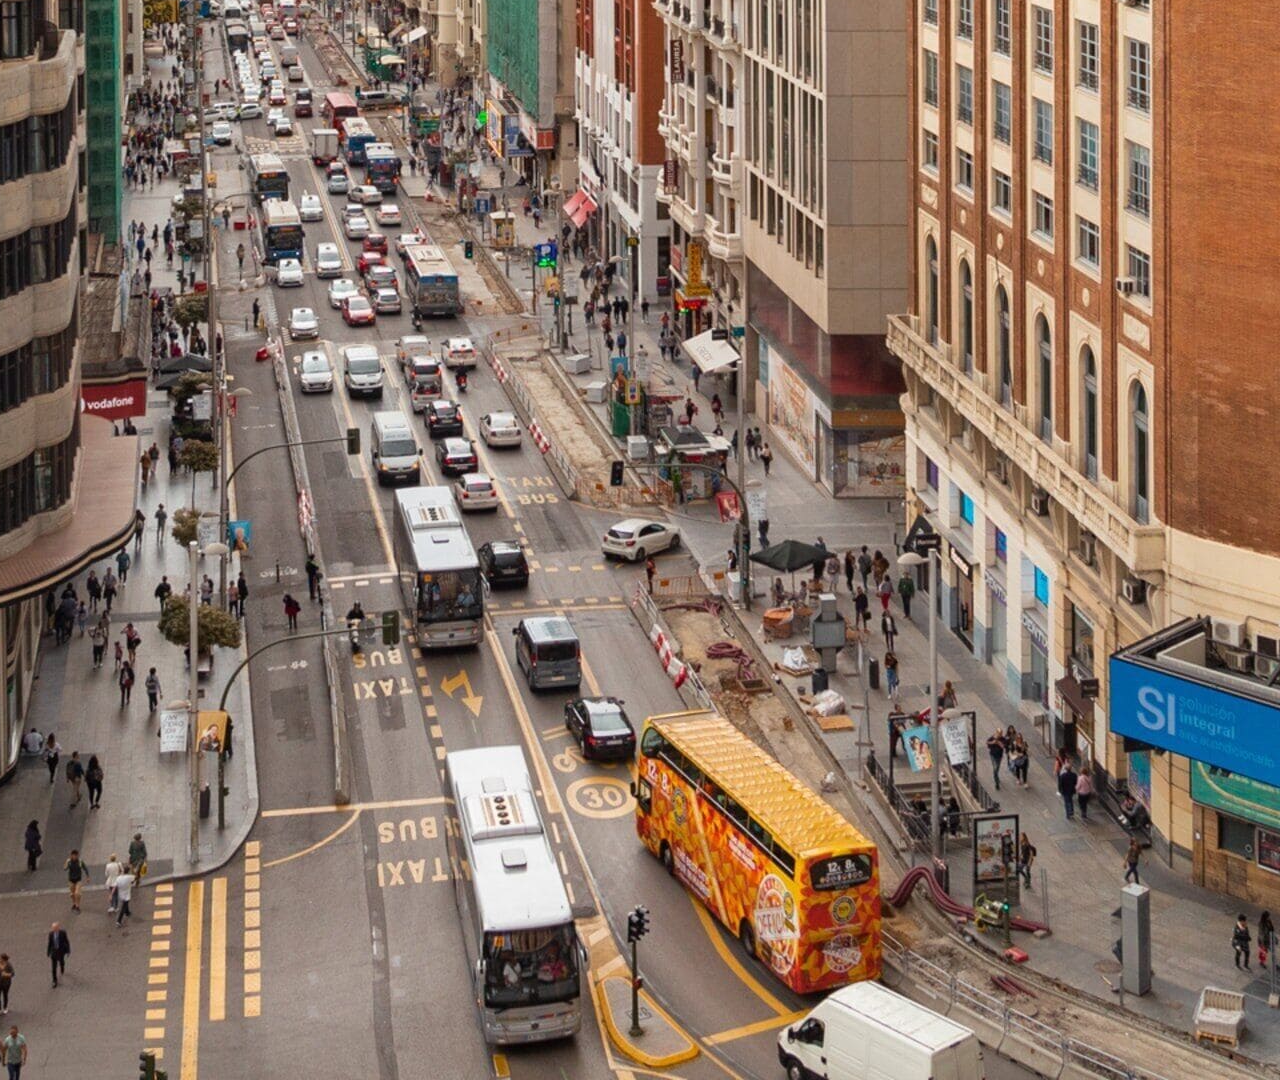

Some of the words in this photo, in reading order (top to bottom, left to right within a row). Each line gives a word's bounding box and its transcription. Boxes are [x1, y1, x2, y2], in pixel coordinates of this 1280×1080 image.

[87, 396, 134, 410] vodafone
[507, 476, 554, 488] TAXI
[517, 493, 559, 505] BUS
[352, 647, 403, 669] BUS
[353, 678, 413, 700] TAXI
[1136, 685, 1176, 736] SI
[1178, 694, 1236, 724] solución
[1179, 711, 1236, 740] integral
[582, 786, 623, 808] 30
[378, 821, 438, 844] BUS
[378, 856, 449, 887] TAXI
